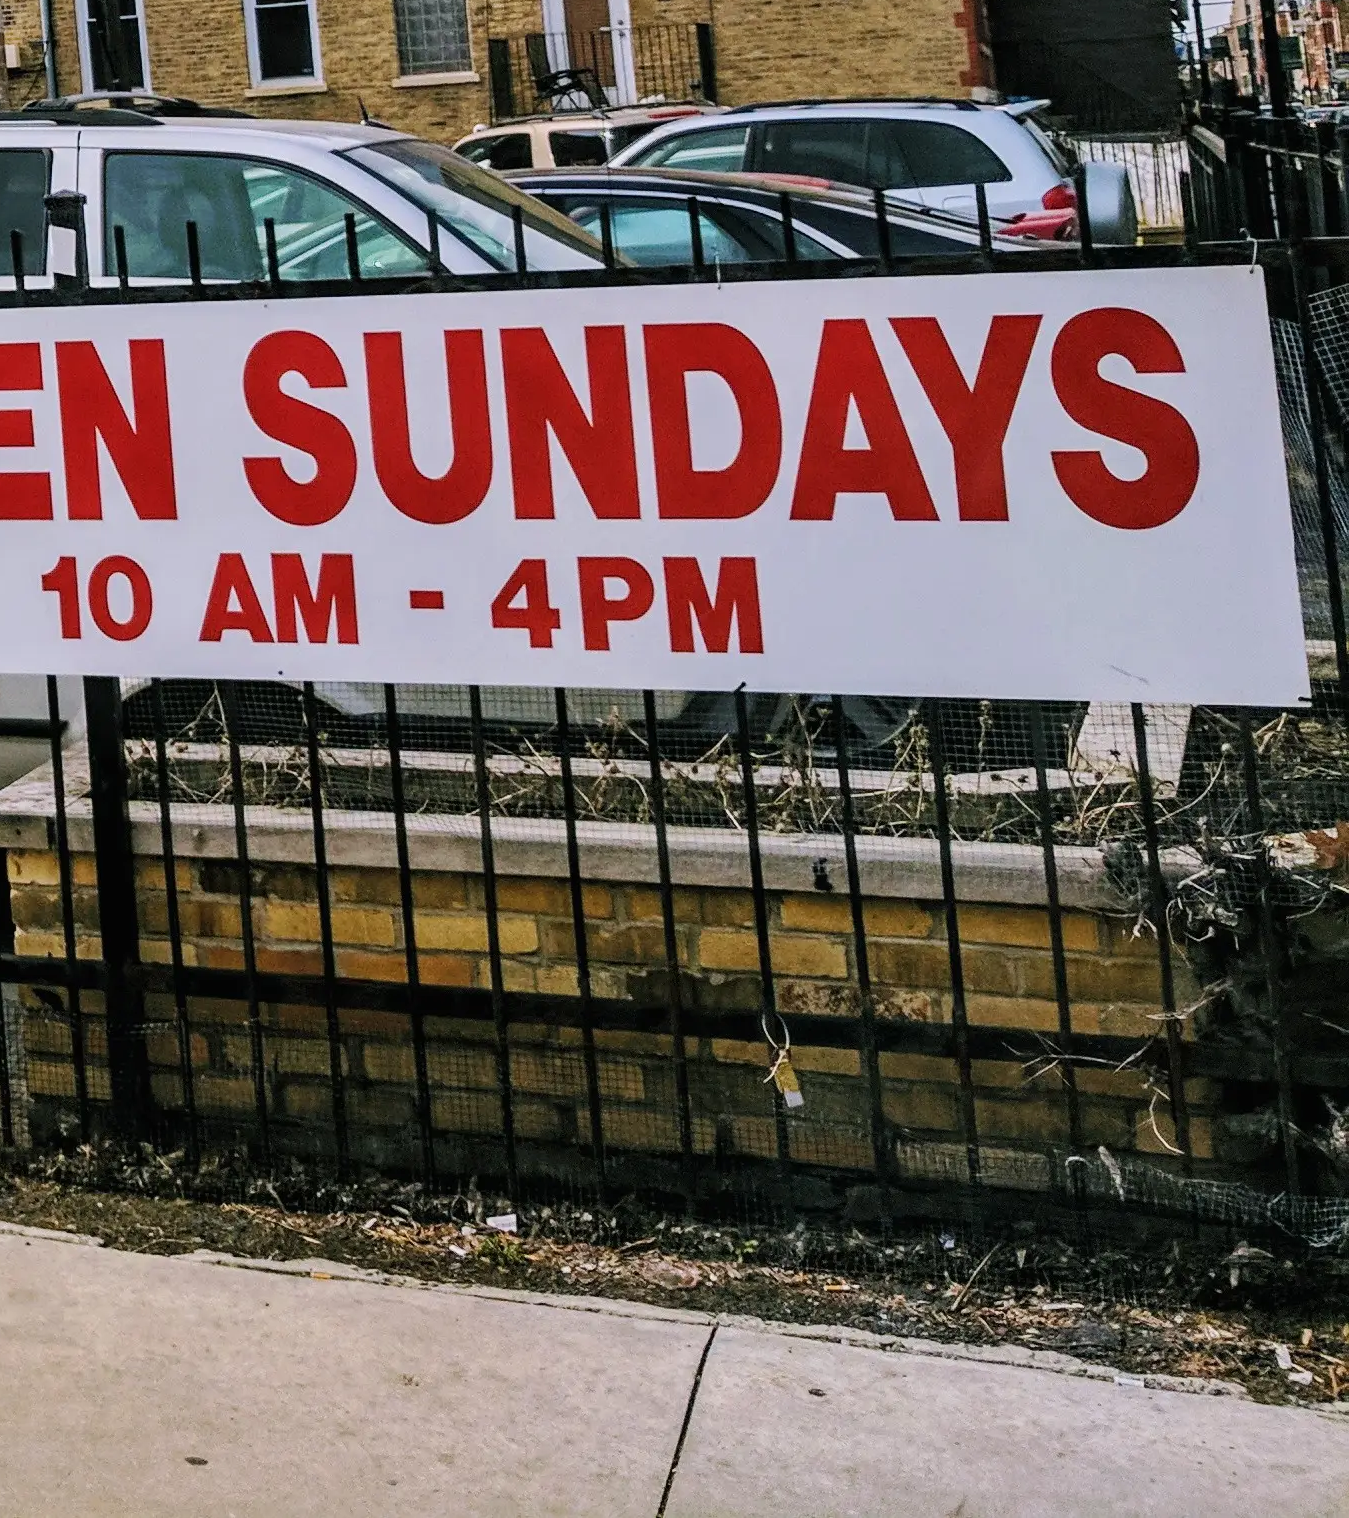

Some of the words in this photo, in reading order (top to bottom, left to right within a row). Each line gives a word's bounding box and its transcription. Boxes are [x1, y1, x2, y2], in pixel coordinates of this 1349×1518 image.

[244, 309, 1197, 528] SUNDAYS
[43, 556, 152, 641] 10
[201, 554, 358, 644] AM
[411, 591, 442, 608] -
